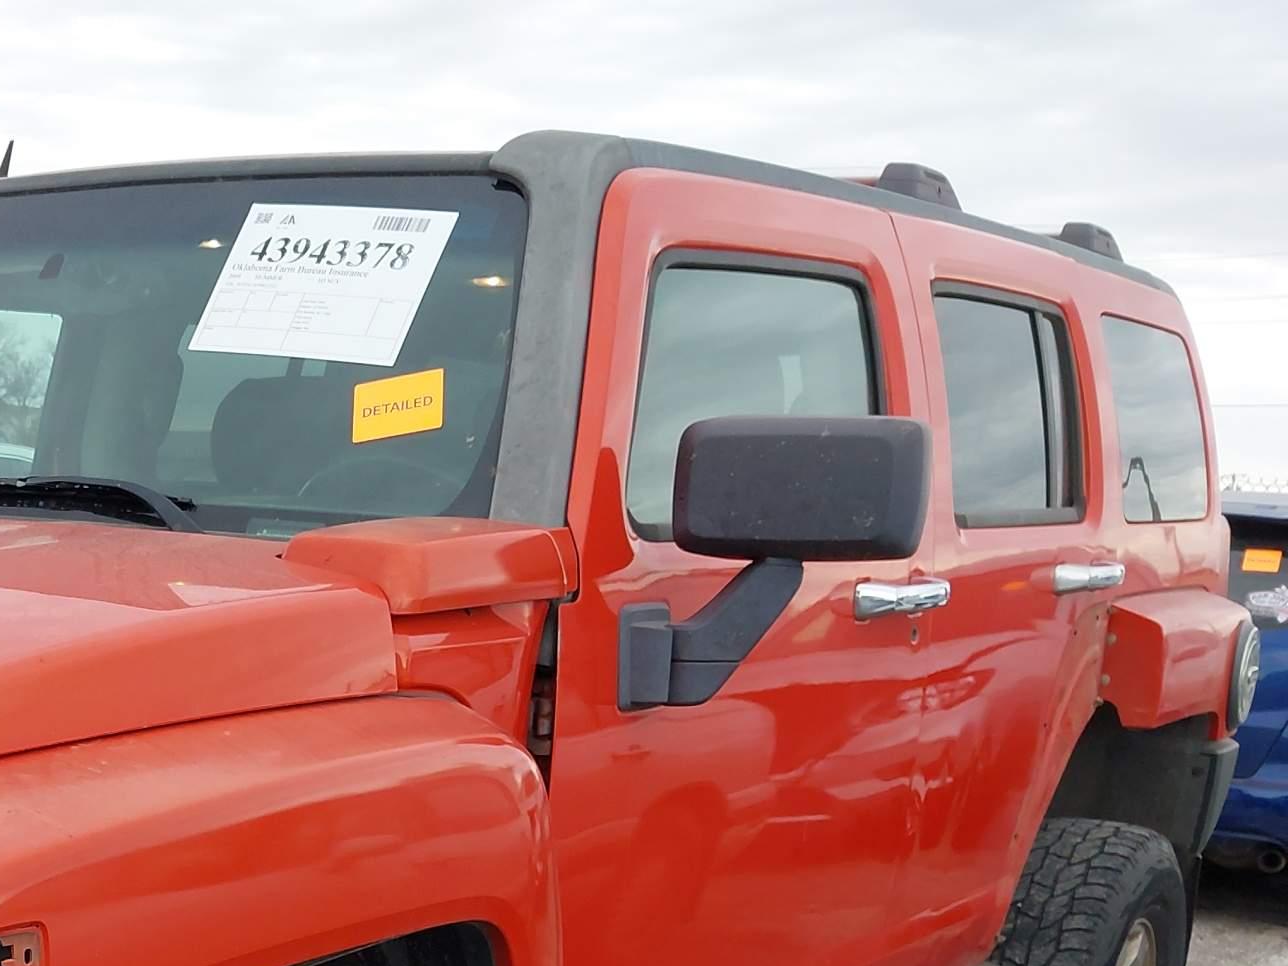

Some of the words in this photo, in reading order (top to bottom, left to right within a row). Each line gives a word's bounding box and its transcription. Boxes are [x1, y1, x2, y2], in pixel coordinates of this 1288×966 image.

[250, 236, 415, 271] 43943378
[231, 263, 273, 273] Oklahoma
[274, 264, 295, 273] Farm
[297, 265, 327, 275] Bureau
[329, 268, 369, 279] Insurance
[362, 395, 433, 418] DETAILED
